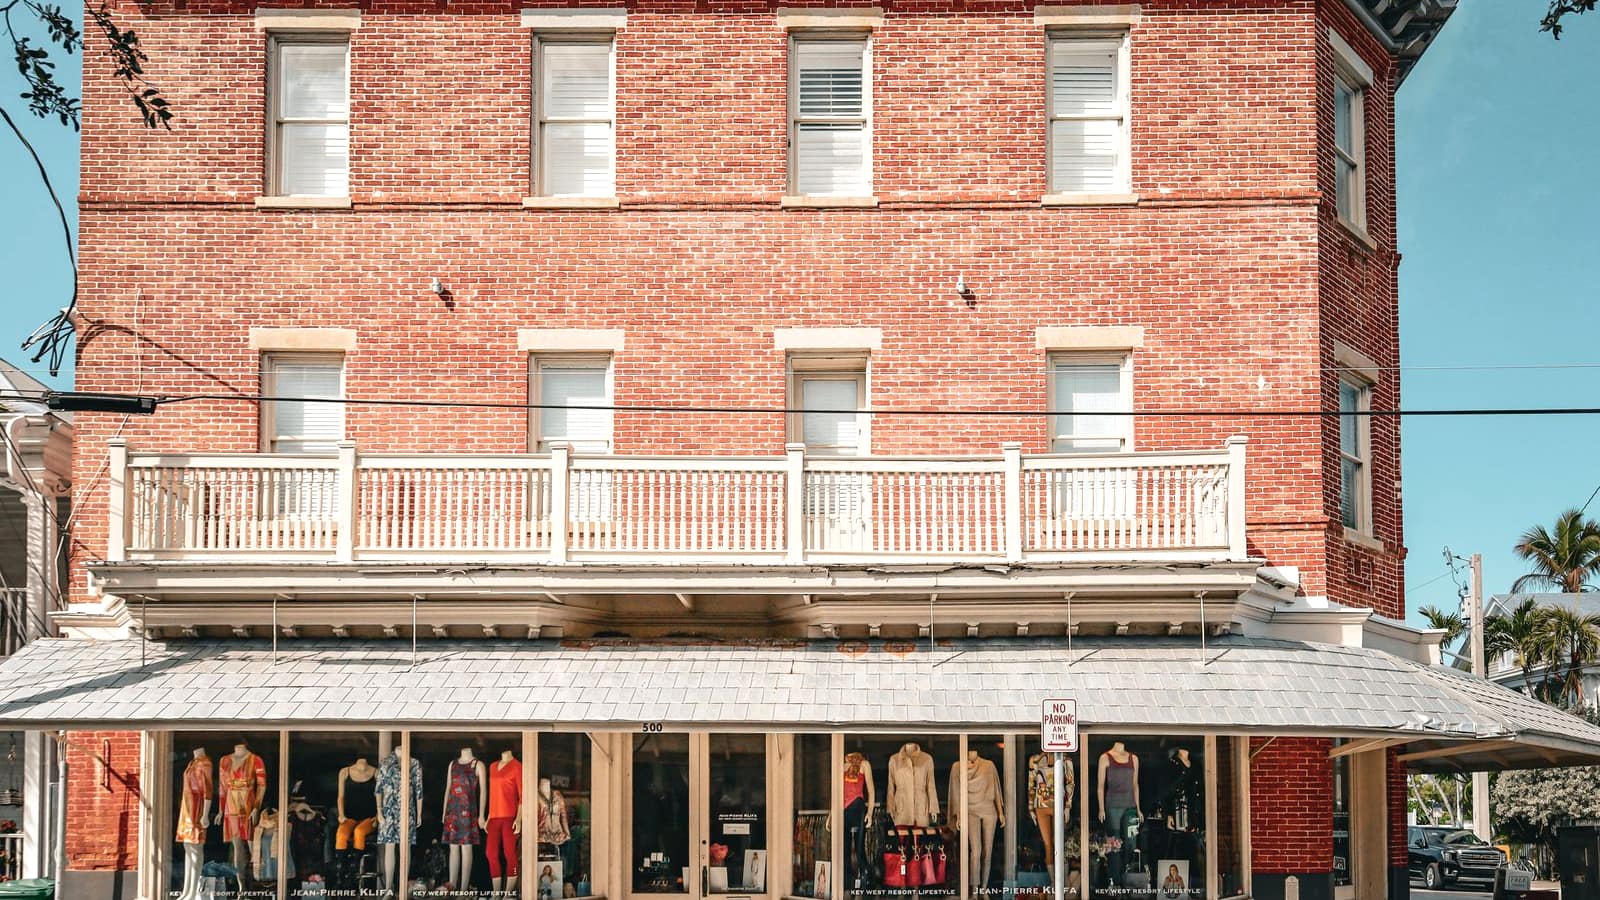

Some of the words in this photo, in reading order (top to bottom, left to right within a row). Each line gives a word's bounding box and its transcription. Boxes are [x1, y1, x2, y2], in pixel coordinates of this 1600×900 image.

[1053, 703, 1066, 713] NO
[1044, 714, 1075, 725] PARKING
[642, 722, 662, 732] 500
[1052, 733, 1068, 741] TIME
[290, 888, 357, 897] JEAN-PIERRE
[360, 888, 394, 897] KLIFA
[973, 887, 1039, 895] JEAN-PIERRE
[1043, 886, 1077, 895] KLFA
